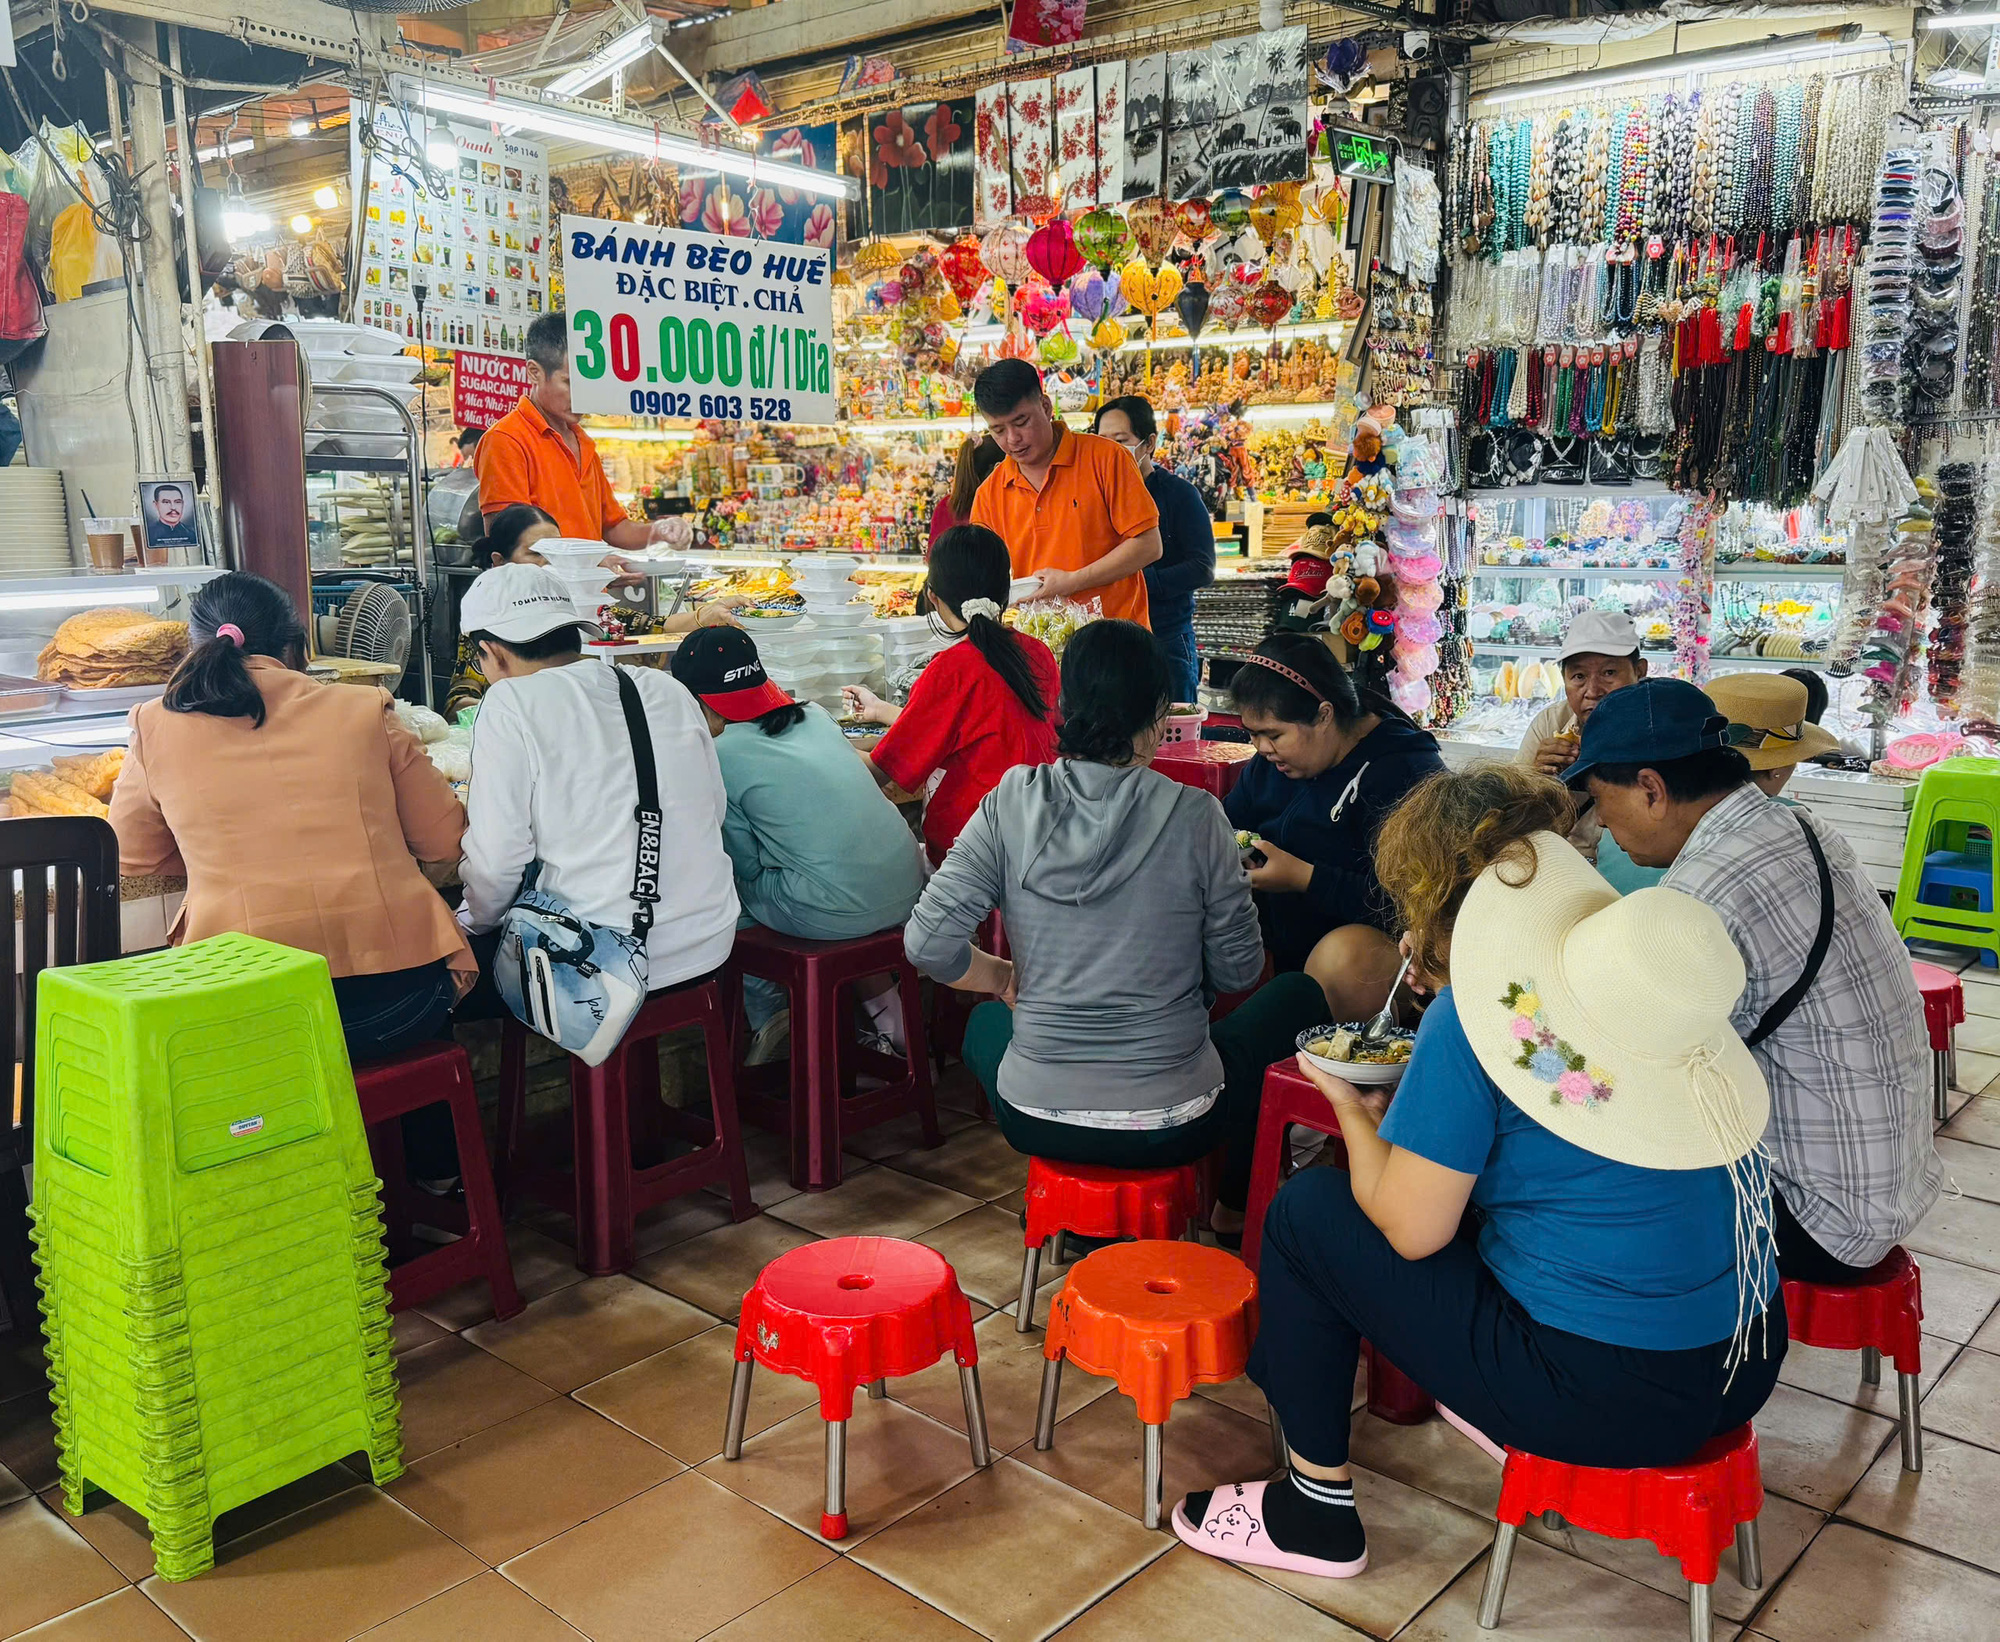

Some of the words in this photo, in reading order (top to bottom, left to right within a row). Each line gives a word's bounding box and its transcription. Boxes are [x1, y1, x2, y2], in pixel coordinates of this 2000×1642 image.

[521, 147, 538, 158] 1146
[571, 227, 676, 268] BÁNH
[686, 240, 752, 275] BÈO
[763, 253, 827, 285] HUẾ
[616, 270, 676, 304] ĐẶC
[684, 277, 739, 311] BIỆT
[754, 285, 804, 314] CHẢ
[573, 309, 743, 388] 30.000
[461, 354, 510, 380] NƯỚC
[460, 375, 518, 398] SUGARCANE
[464, 392, 484, 408] Mía
[630, 389, 692, 417] 0902
[700, 394, 743, 420] 603
[750, 397, 792, 422] 528
[463, 409, 483, 425] Mía
